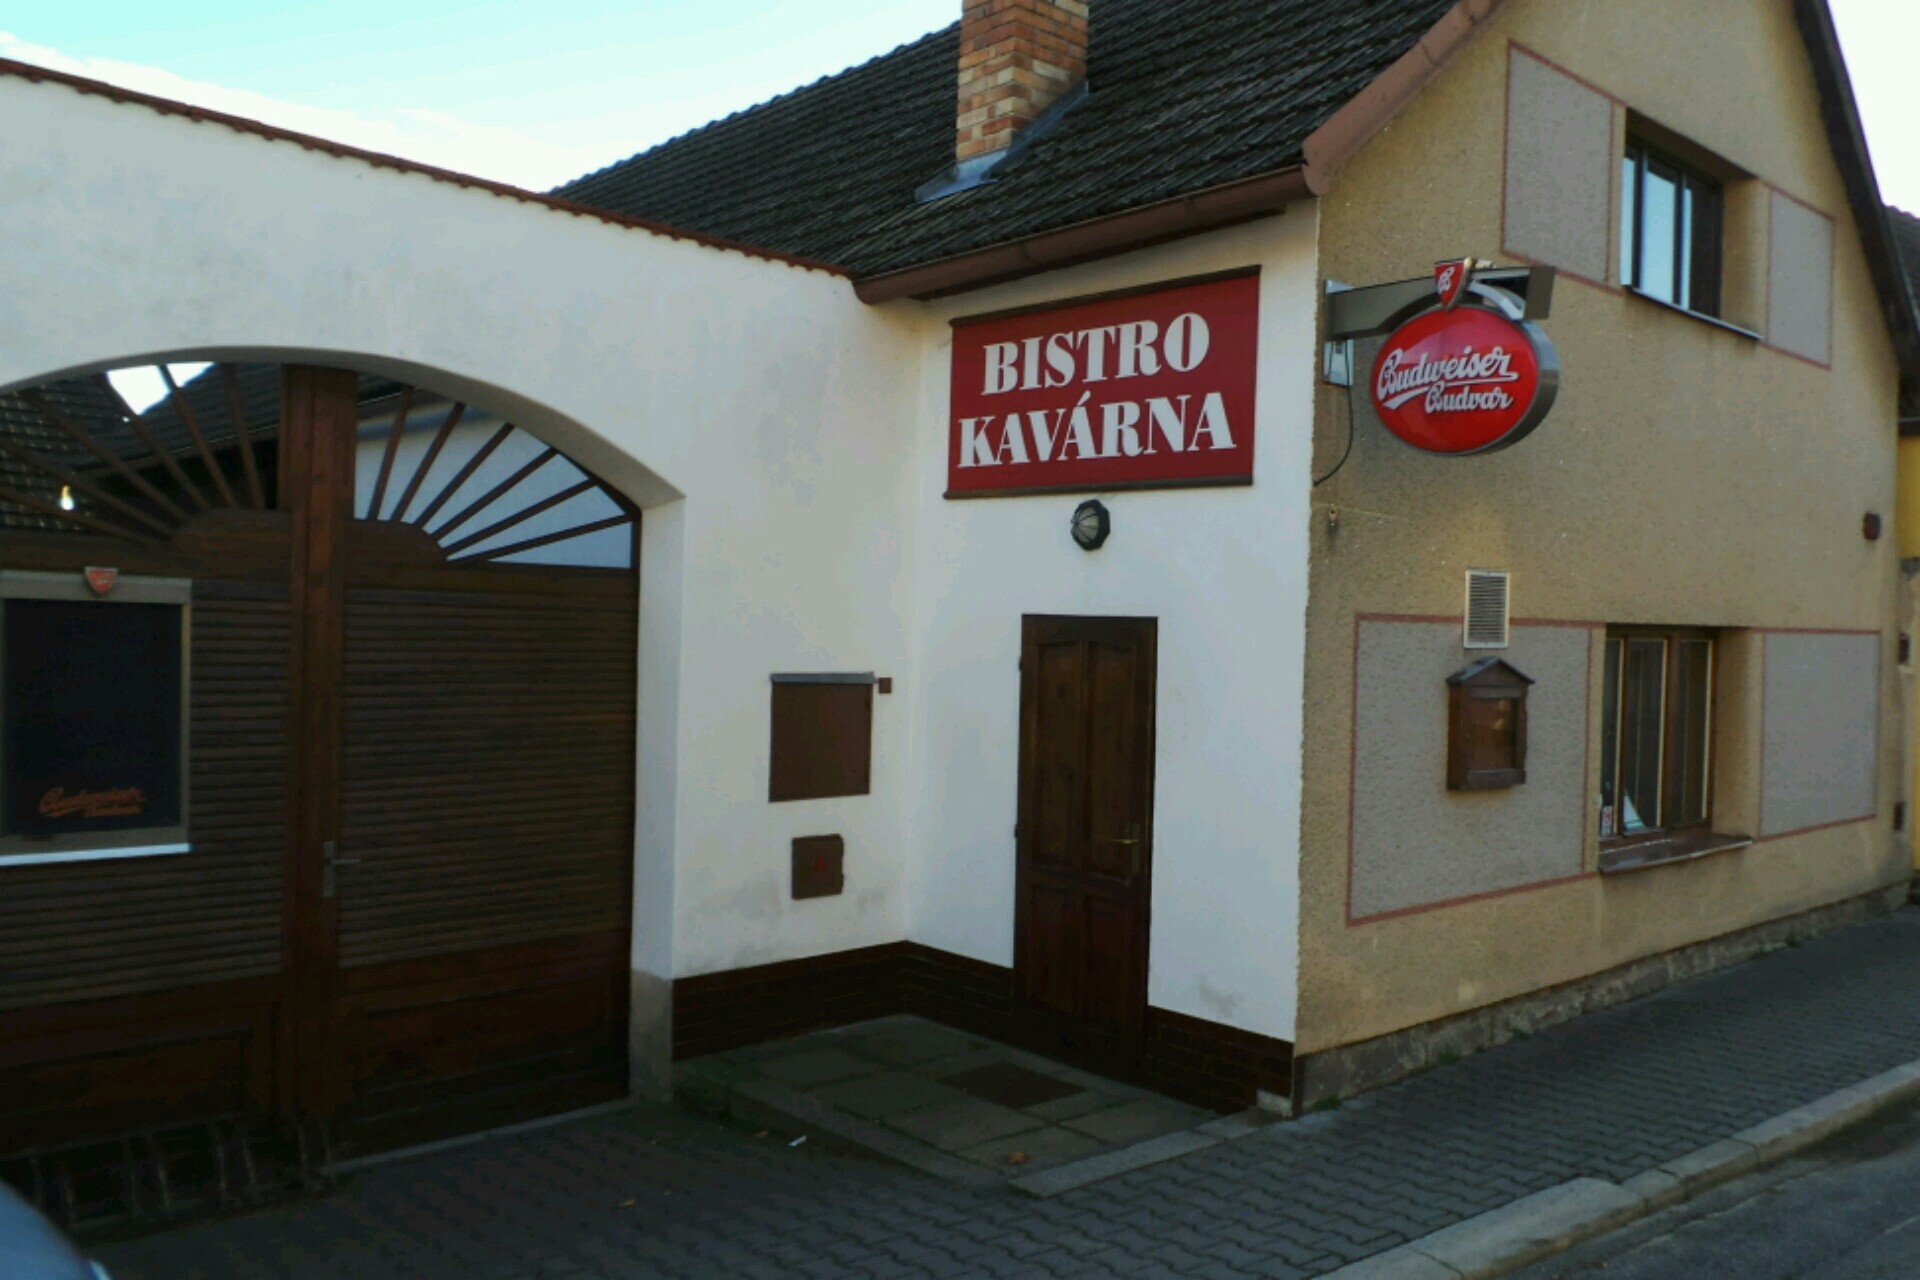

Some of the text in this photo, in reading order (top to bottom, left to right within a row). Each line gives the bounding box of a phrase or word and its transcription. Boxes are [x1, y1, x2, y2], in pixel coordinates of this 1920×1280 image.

[981, 313, 1210, 396] BISTRO
[1377, 345, 1519, 401] Budweiser
[957, 391, 1237, 469] KAVÁRNA
[1424, 383, 1513, 414] Budvar
